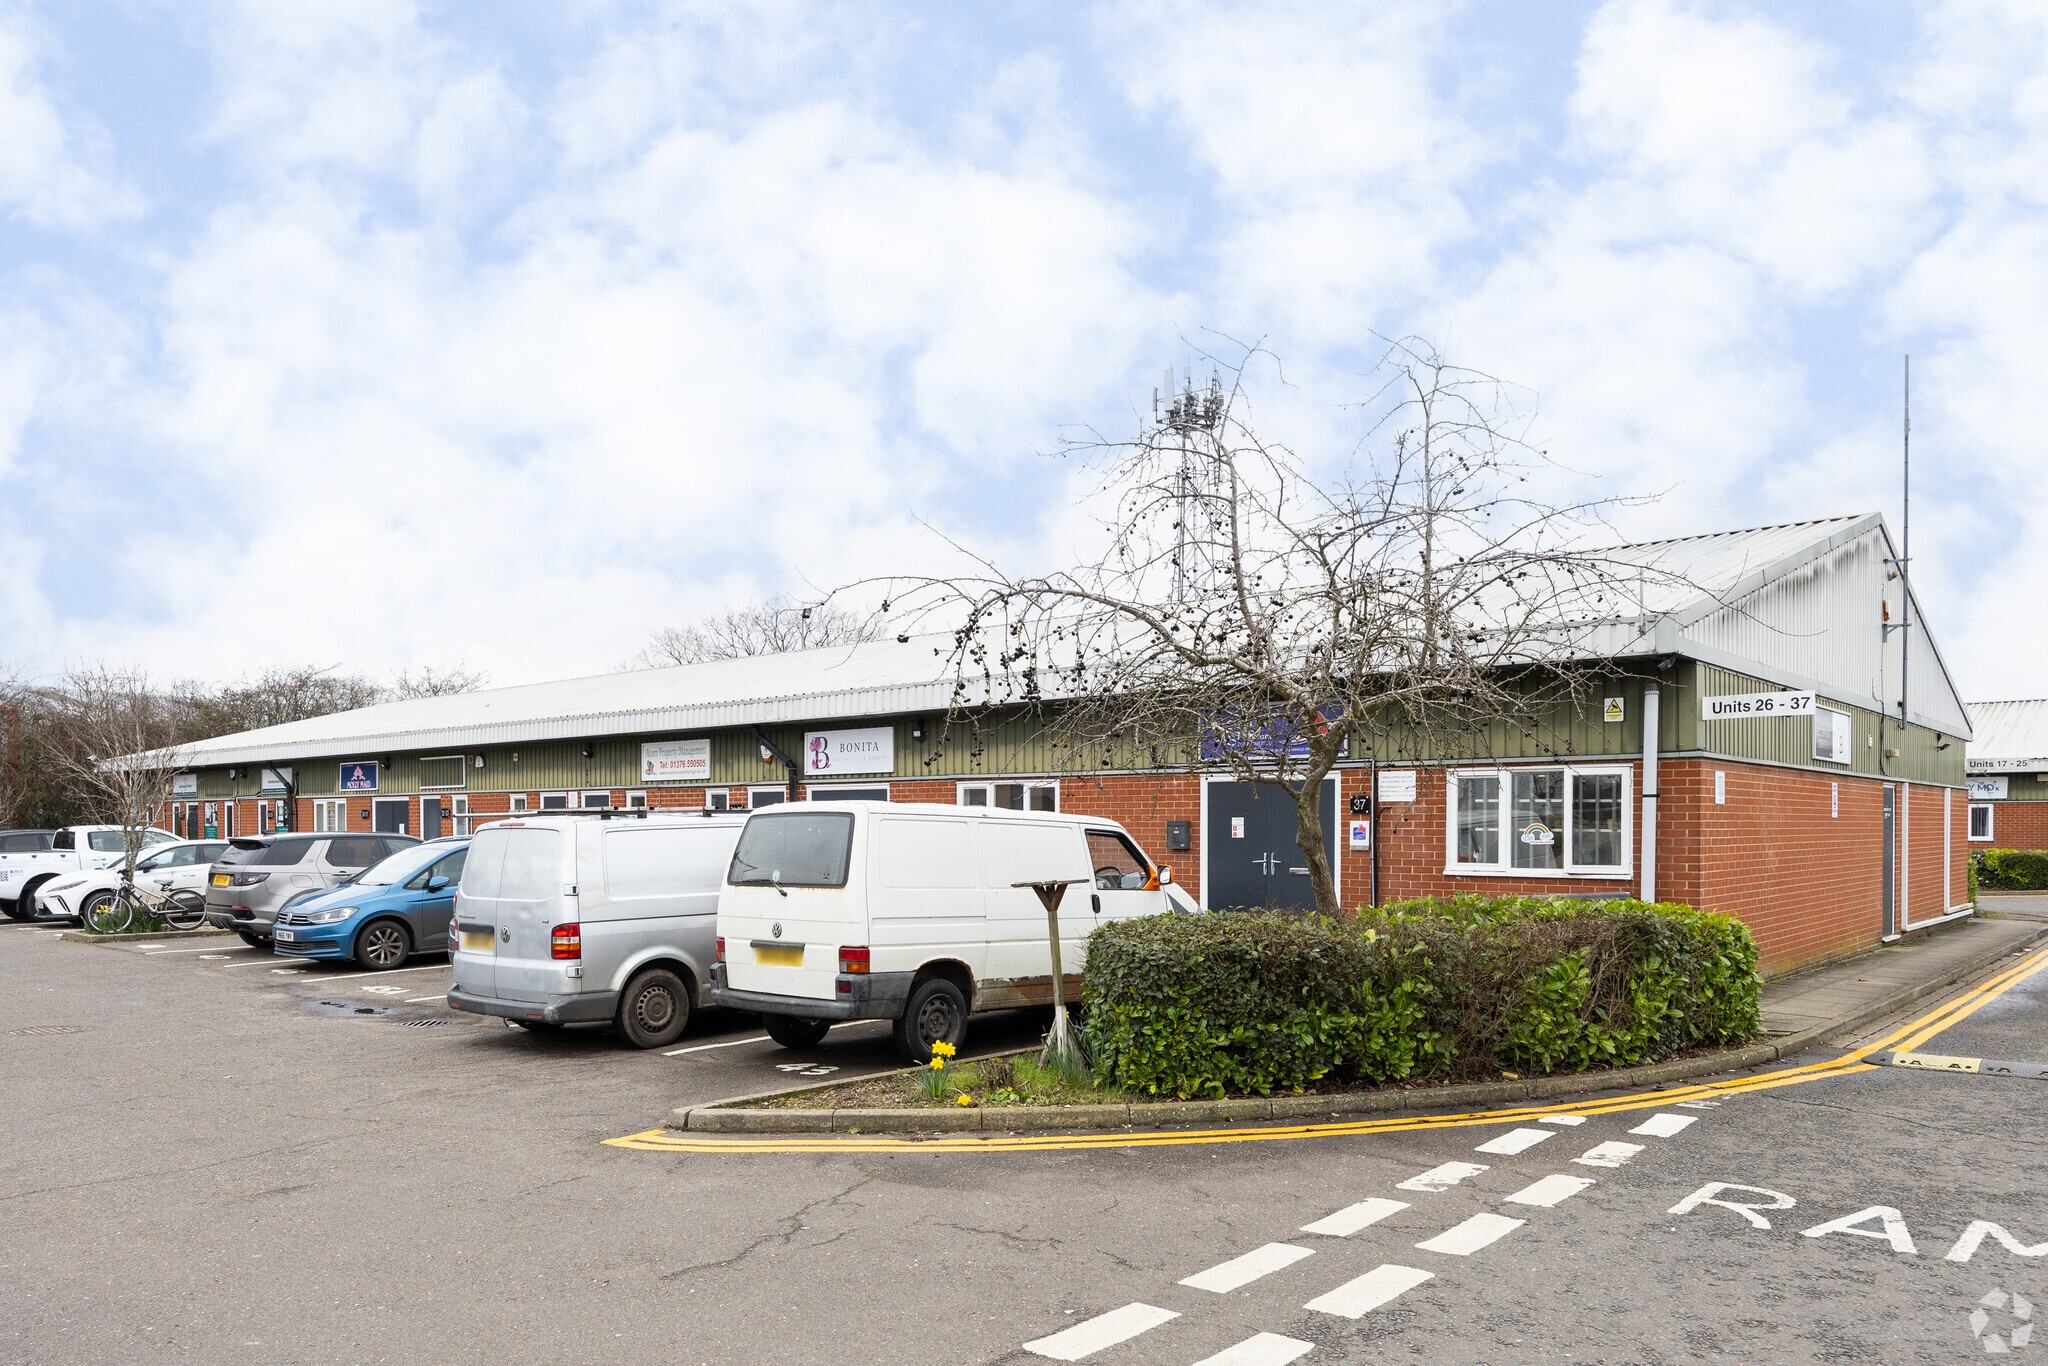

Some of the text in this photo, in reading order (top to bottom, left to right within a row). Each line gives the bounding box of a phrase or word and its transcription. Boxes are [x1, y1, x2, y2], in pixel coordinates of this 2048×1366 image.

[1712, 701, 1751, 714] Units
[1755, 698, 1774, 711] 26
[1790, 697, 1811, 709] 37
[839, 742, 879, 753] BONITA
[669, 760, 686, 769] 01376
[1969, 760, 1994, 768] Units
[1353, 798, 1366, 811] 37
[775, 1063, 840, 1076] 43
